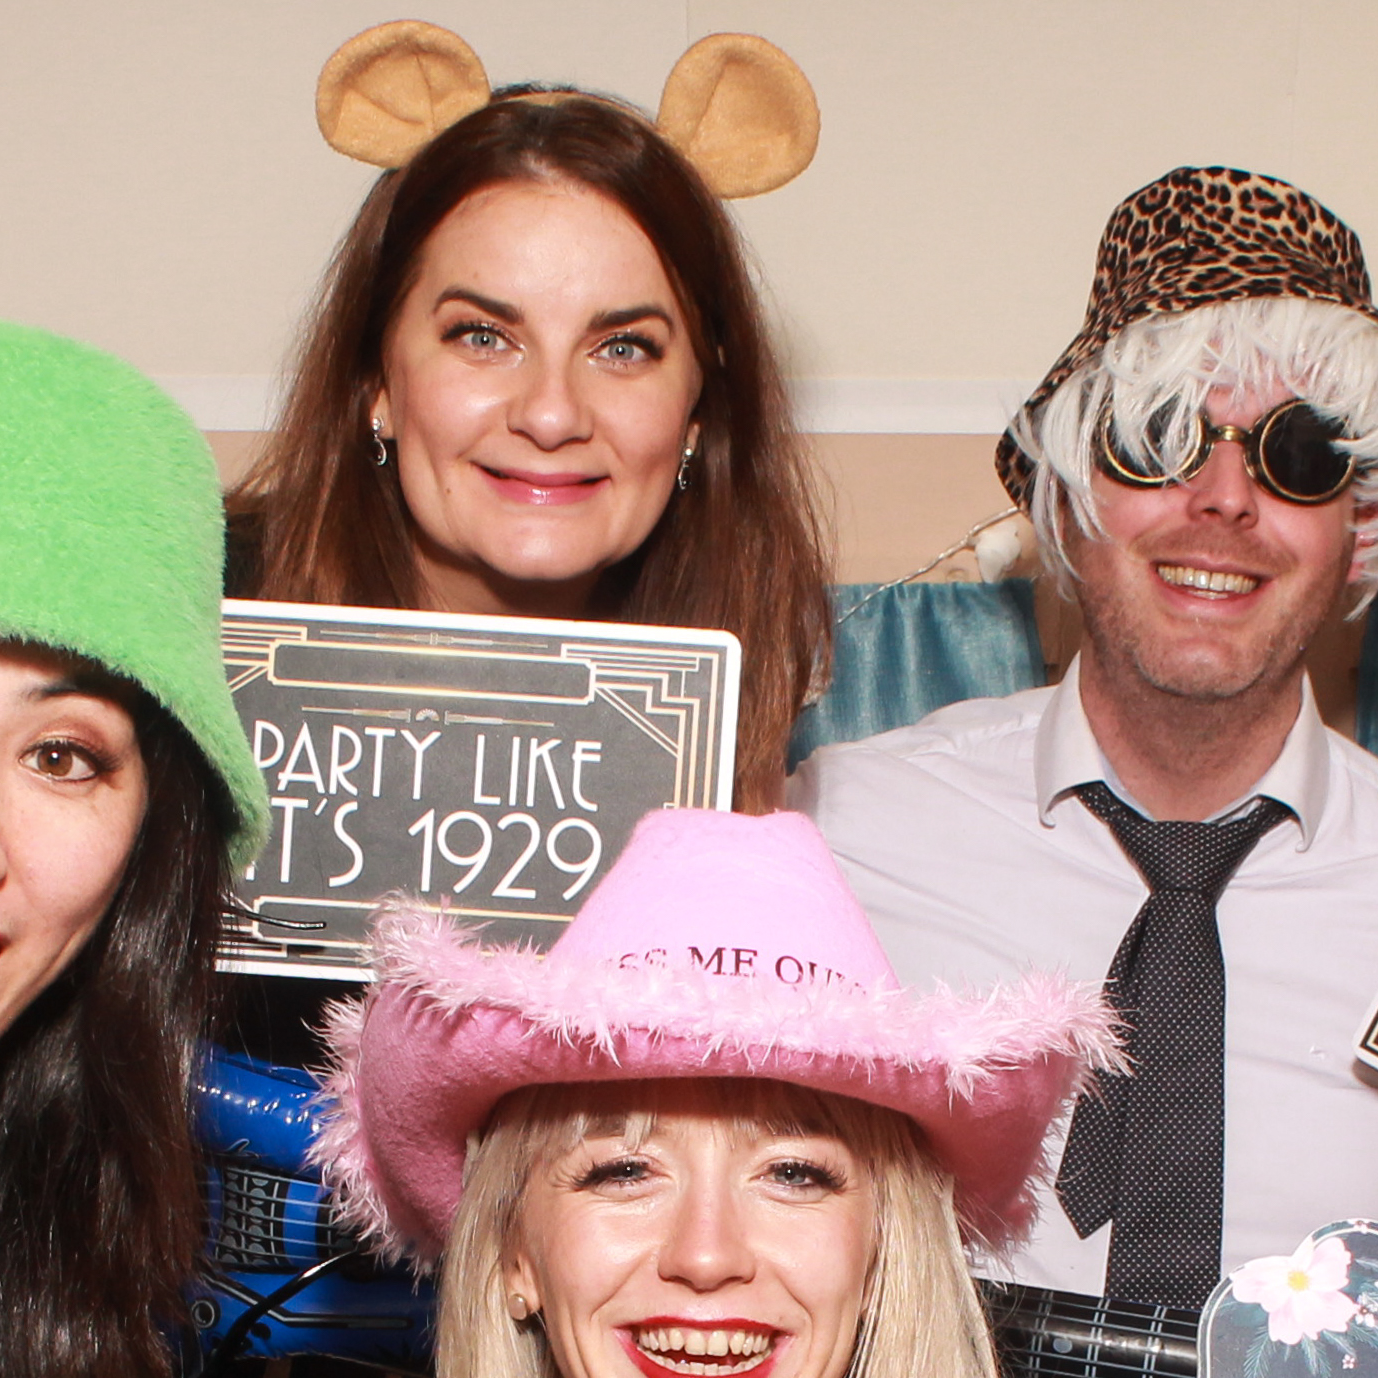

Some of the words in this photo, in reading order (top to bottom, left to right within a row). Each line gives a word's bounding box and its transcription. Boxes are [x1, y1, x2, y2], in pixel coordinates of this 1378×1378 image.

[253, 719, 442, 801] PARTY
[473, 733, 603, 813] LIKE
[245, 796, 365, 889] T'S
[407, 807, 603, 901] 1929
[687, 946, 758, 978] ME
